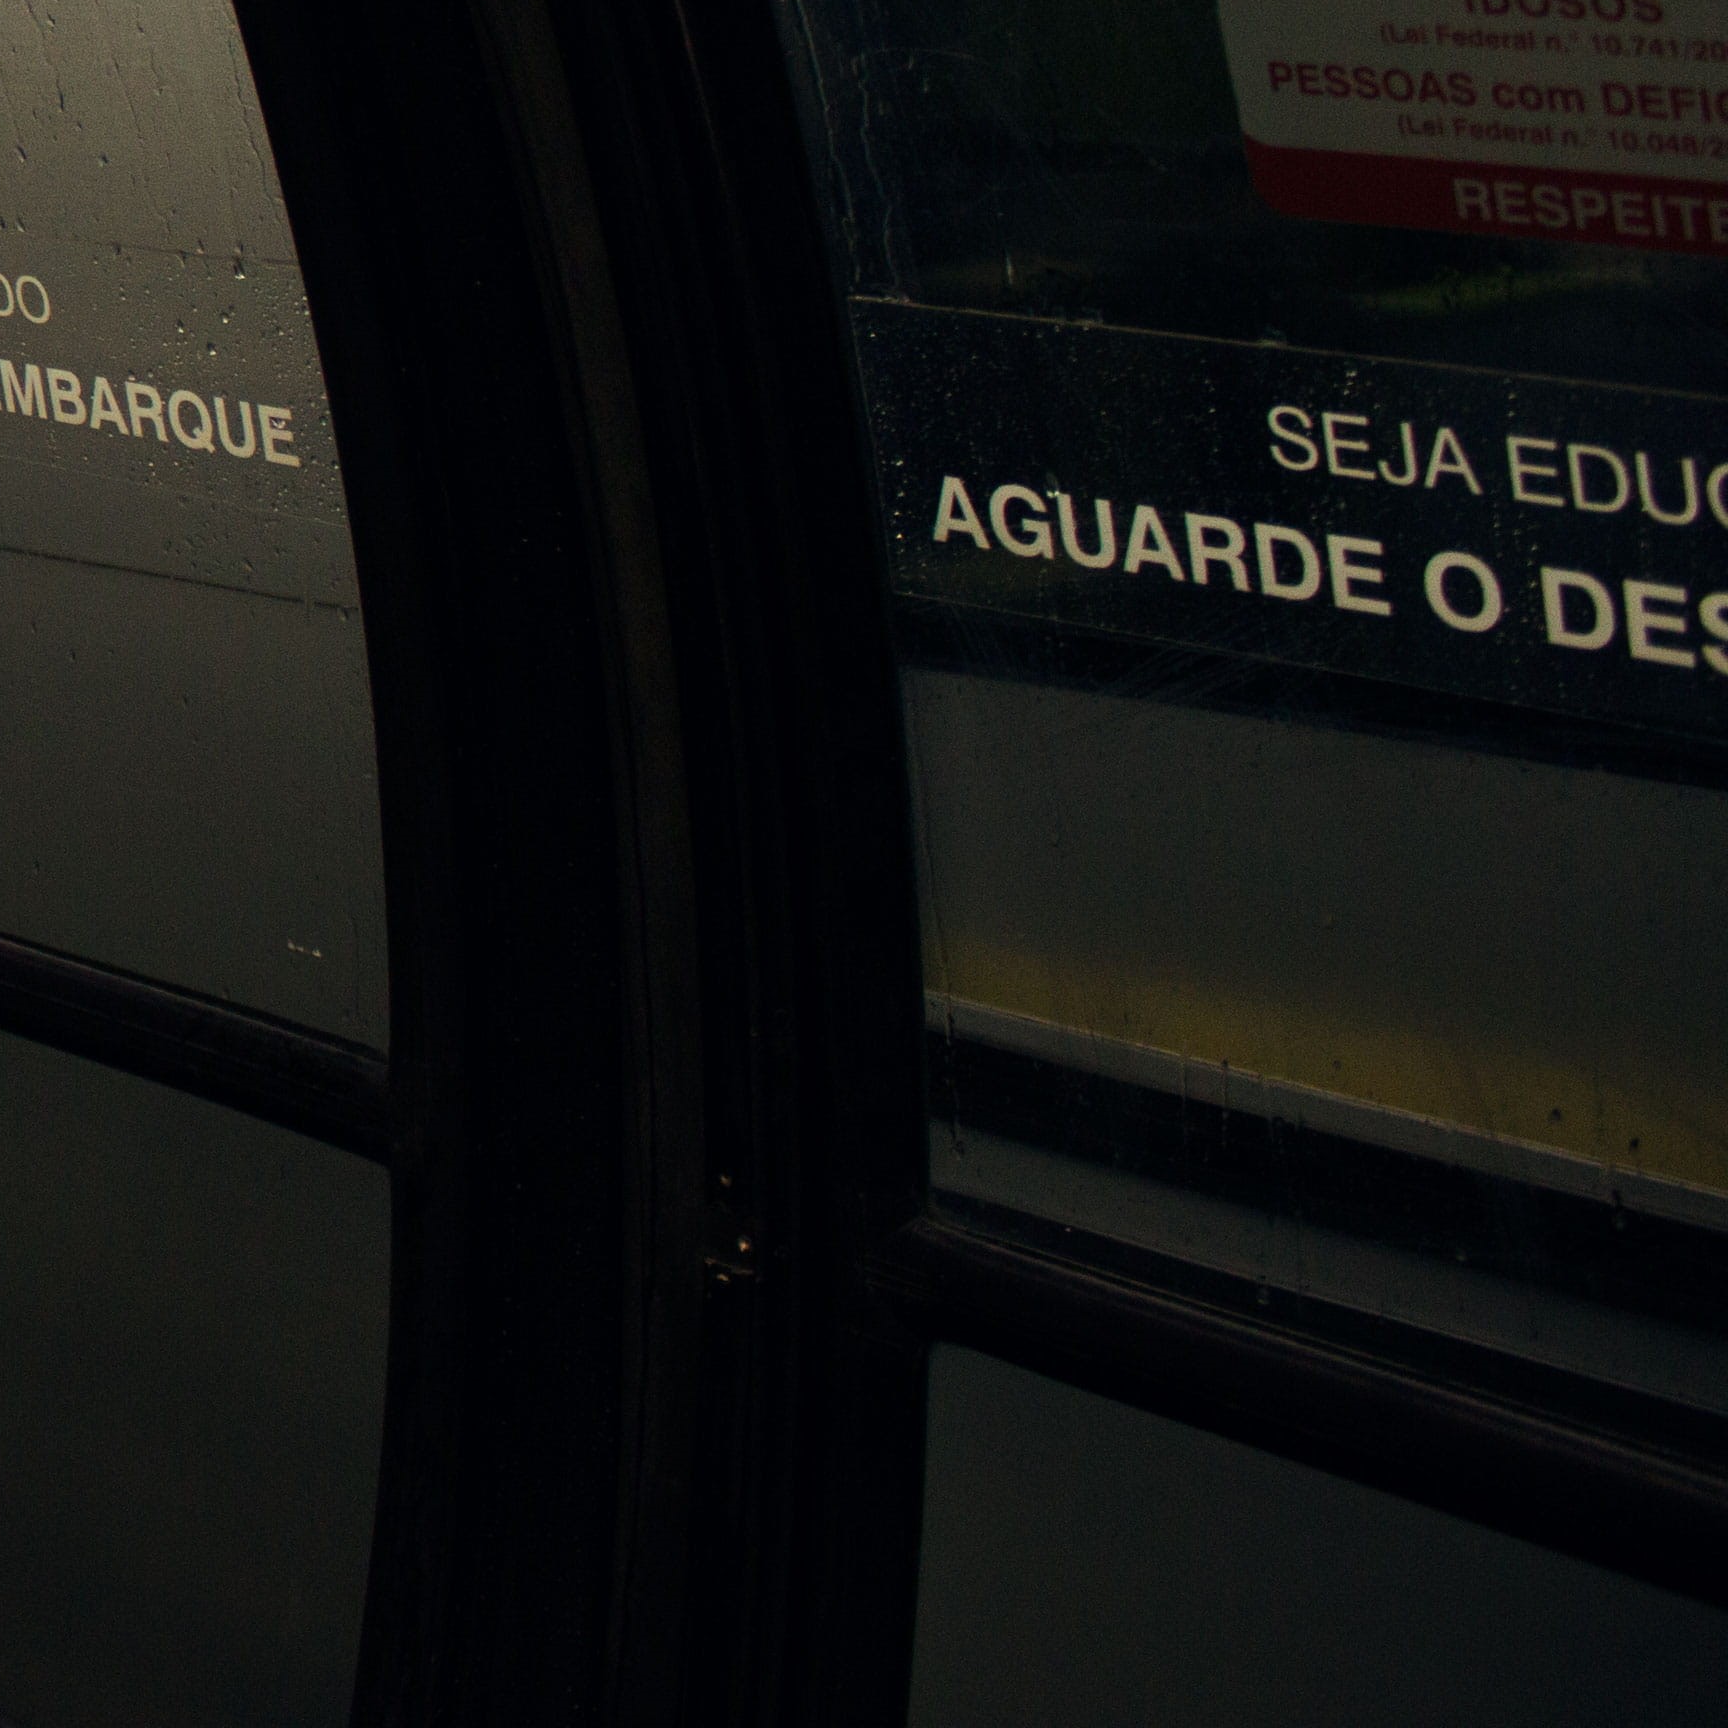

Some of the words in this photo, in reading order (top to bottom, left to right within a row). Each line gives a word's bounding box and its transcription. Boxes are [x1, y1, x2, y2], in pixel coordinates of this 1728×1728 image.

[1435, 24, 1536, 52] Federal
[1268, 61, 1478, 107] PESSOAS
[1491, 82, 1586, 114] com
[1454, 117, 1554, 145] Federal
[1266, 404, 1485, 496] SEJA
[932, 475, 1395, 618] AGUARDE
[1422, 549, 1506, 634] O
